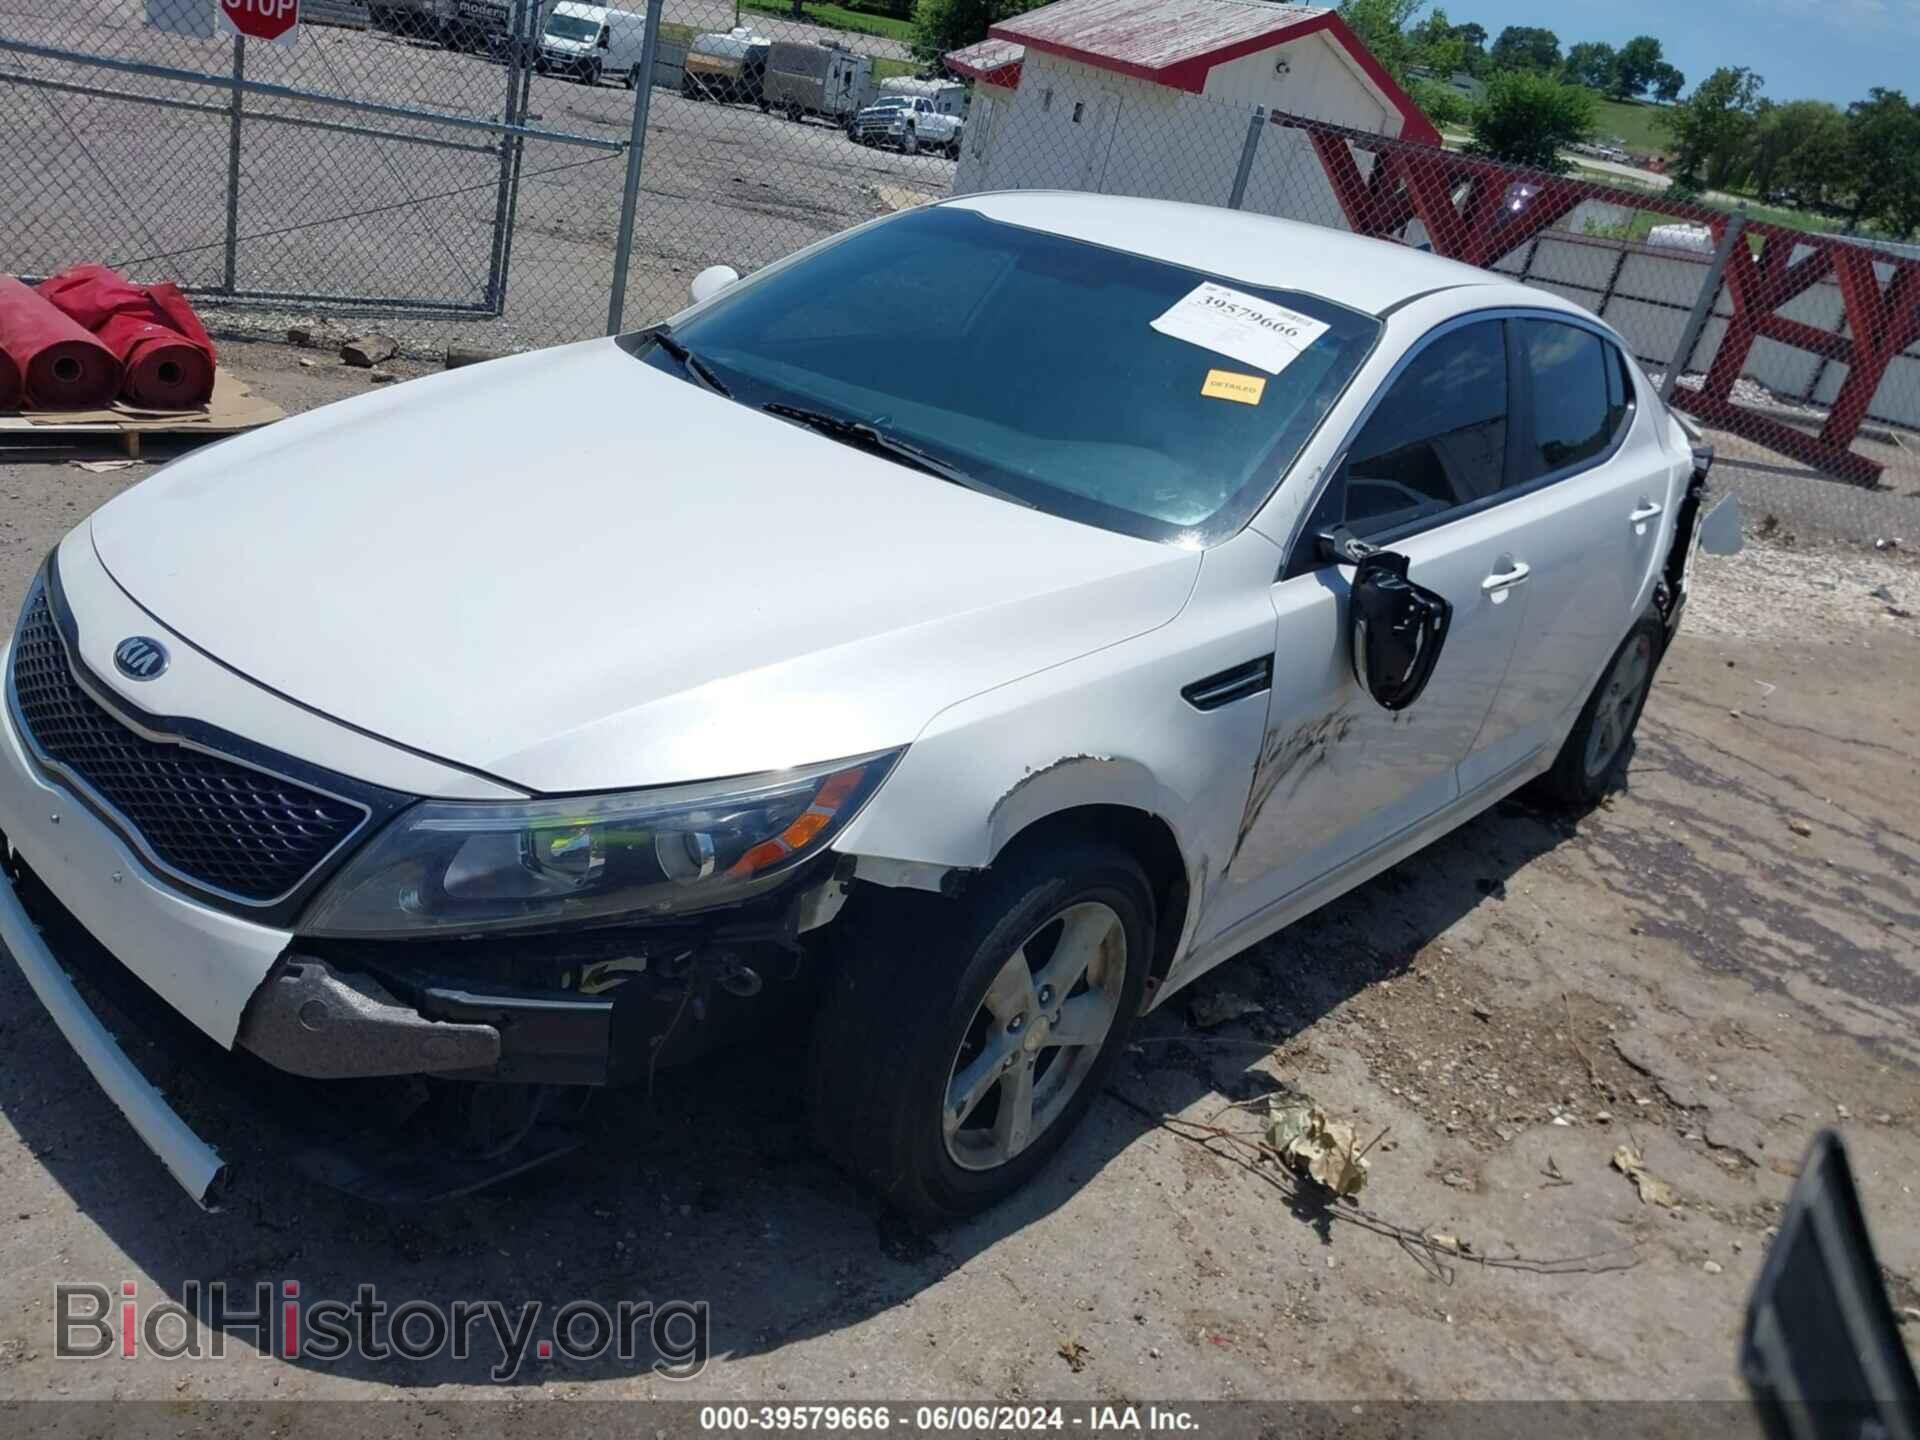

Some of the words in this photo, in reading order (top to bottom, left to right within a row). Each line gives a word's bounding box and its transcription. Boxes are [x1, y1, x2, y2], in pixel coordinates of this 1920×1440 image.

[1198, 296, 1298, 336] 39579666
[1210, 379, 1257, 395] DETAILED
[117, 638, 160, 675] KIA
